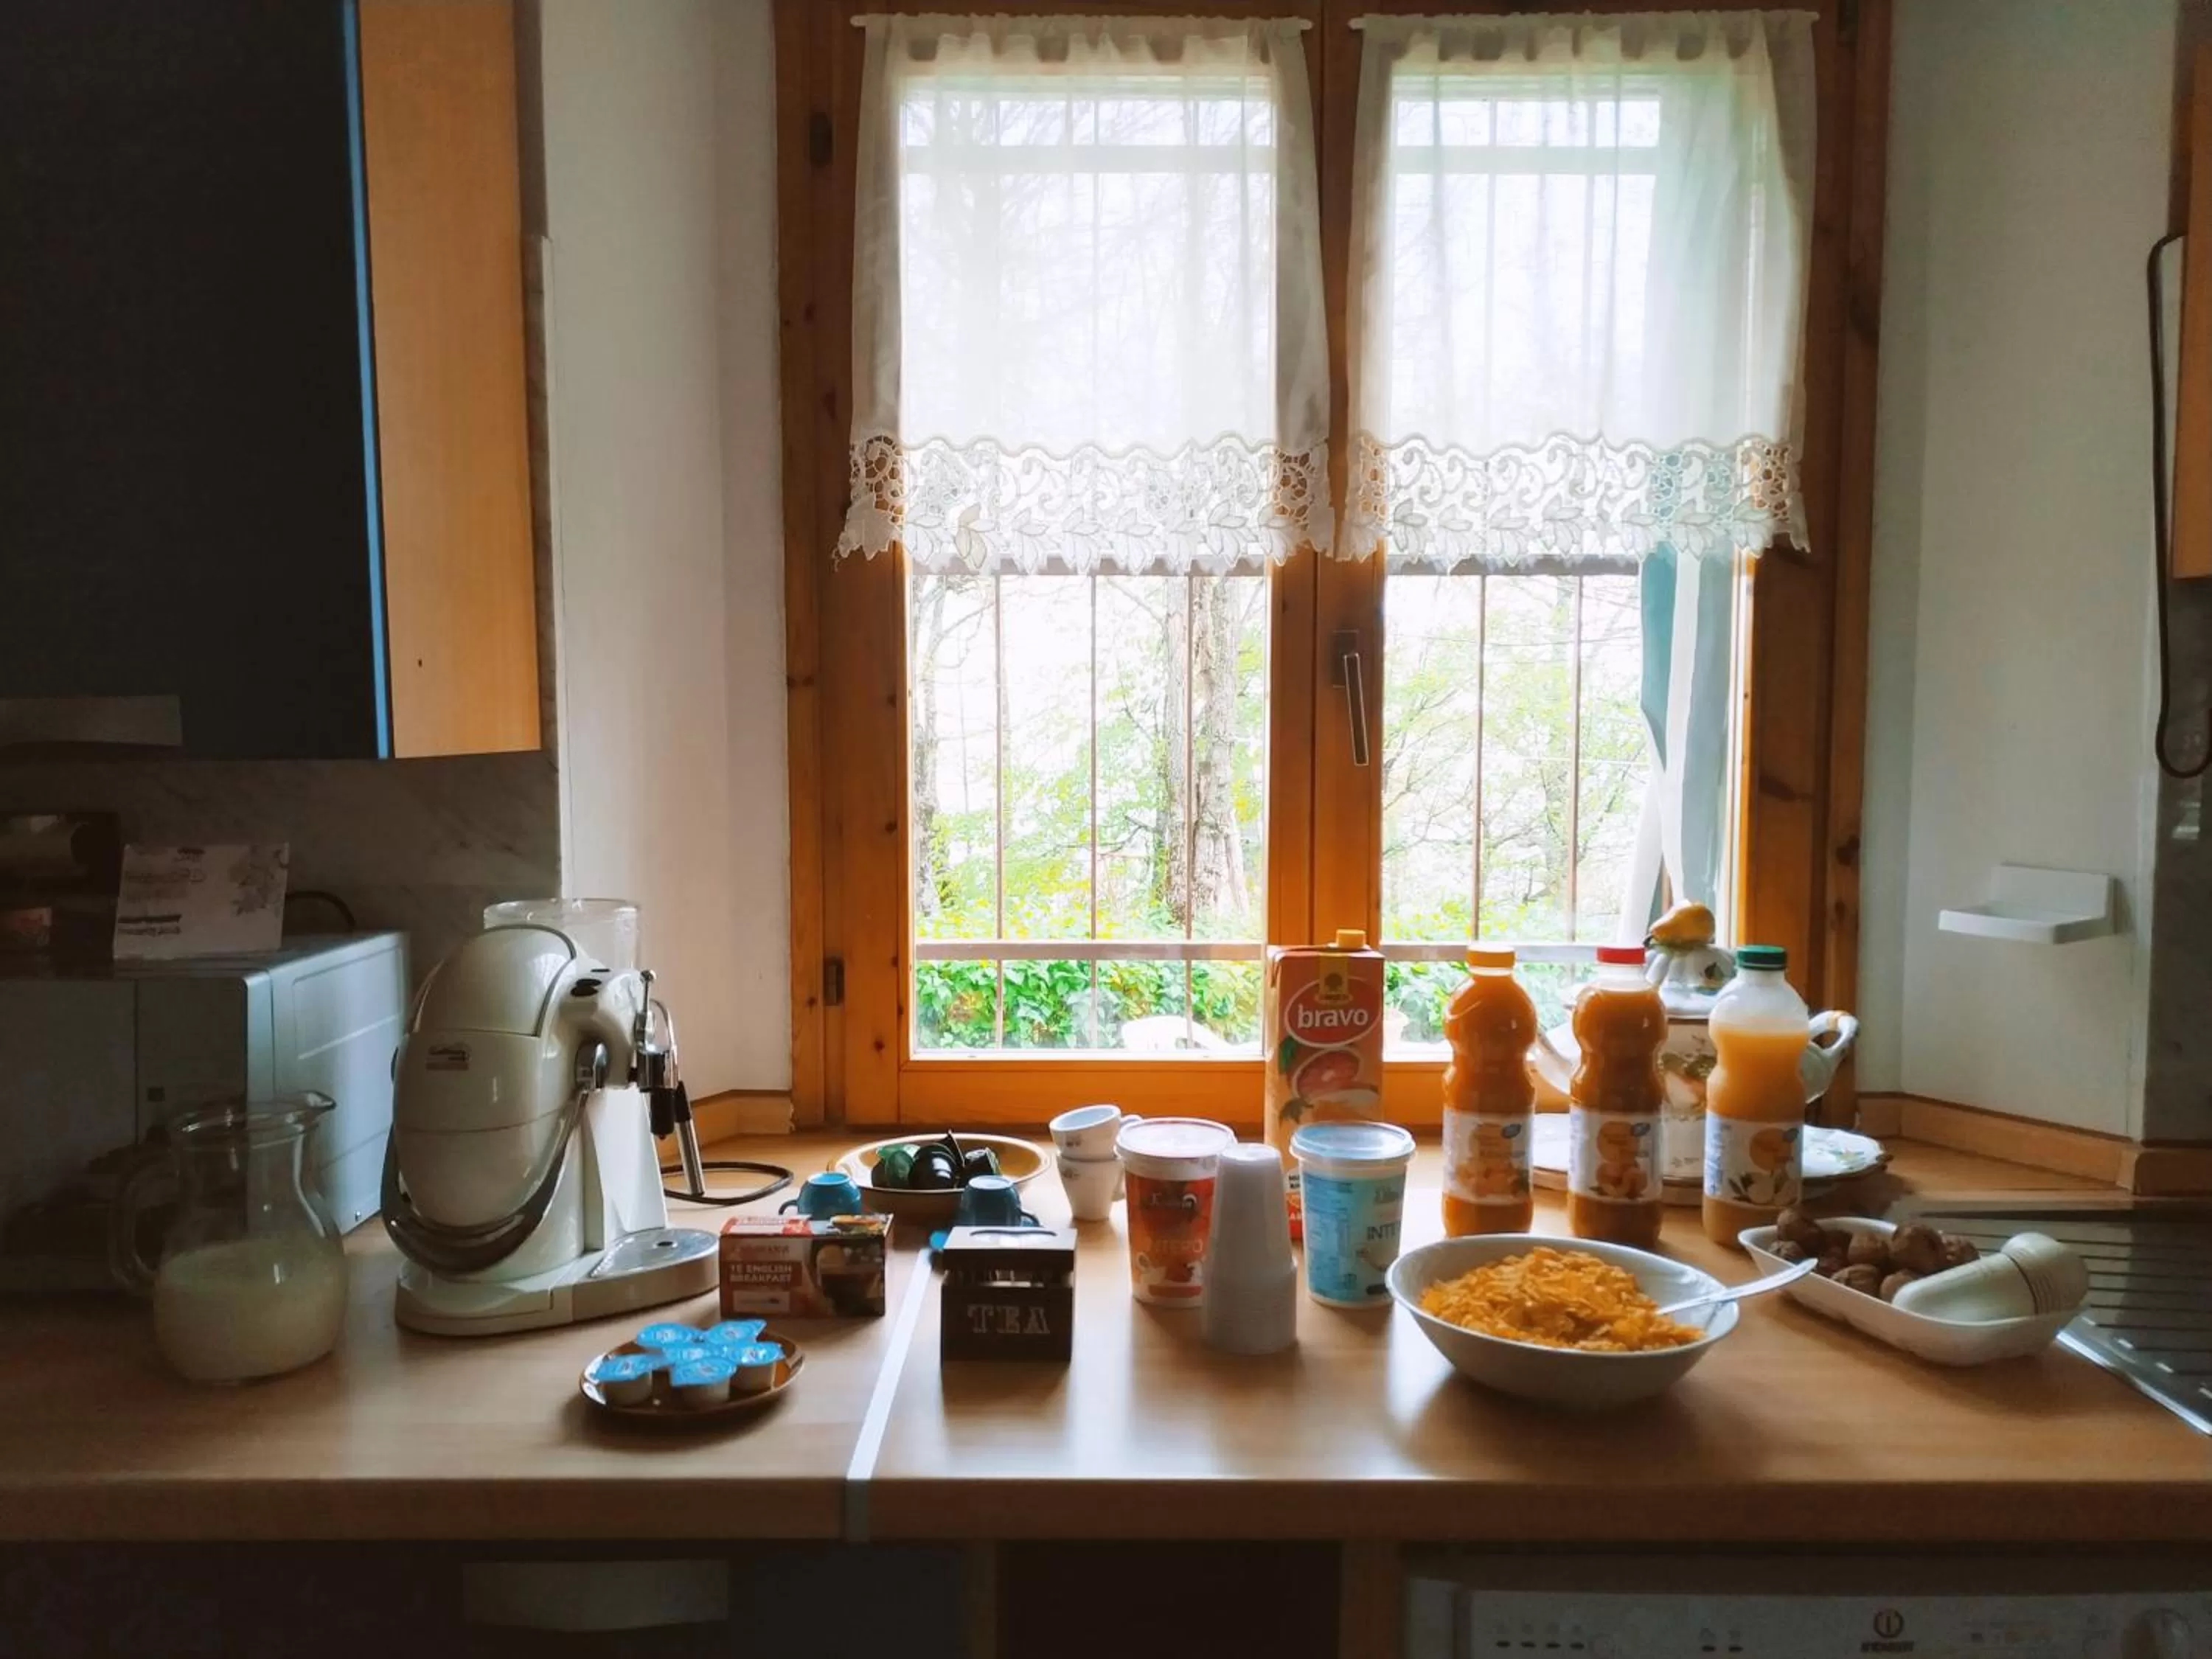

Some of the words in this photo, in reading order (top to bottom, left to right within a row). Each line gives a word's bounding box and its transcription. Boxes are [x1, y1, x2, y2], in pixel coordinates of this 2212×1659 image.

[1297, 1004, 1369, 1029] bravo
[745, 1263, 792, 1273] ENGLISH
[730, 1273, 792, 1283] BREAKFAST
[967, 1304, 1051, 1334] TEA
